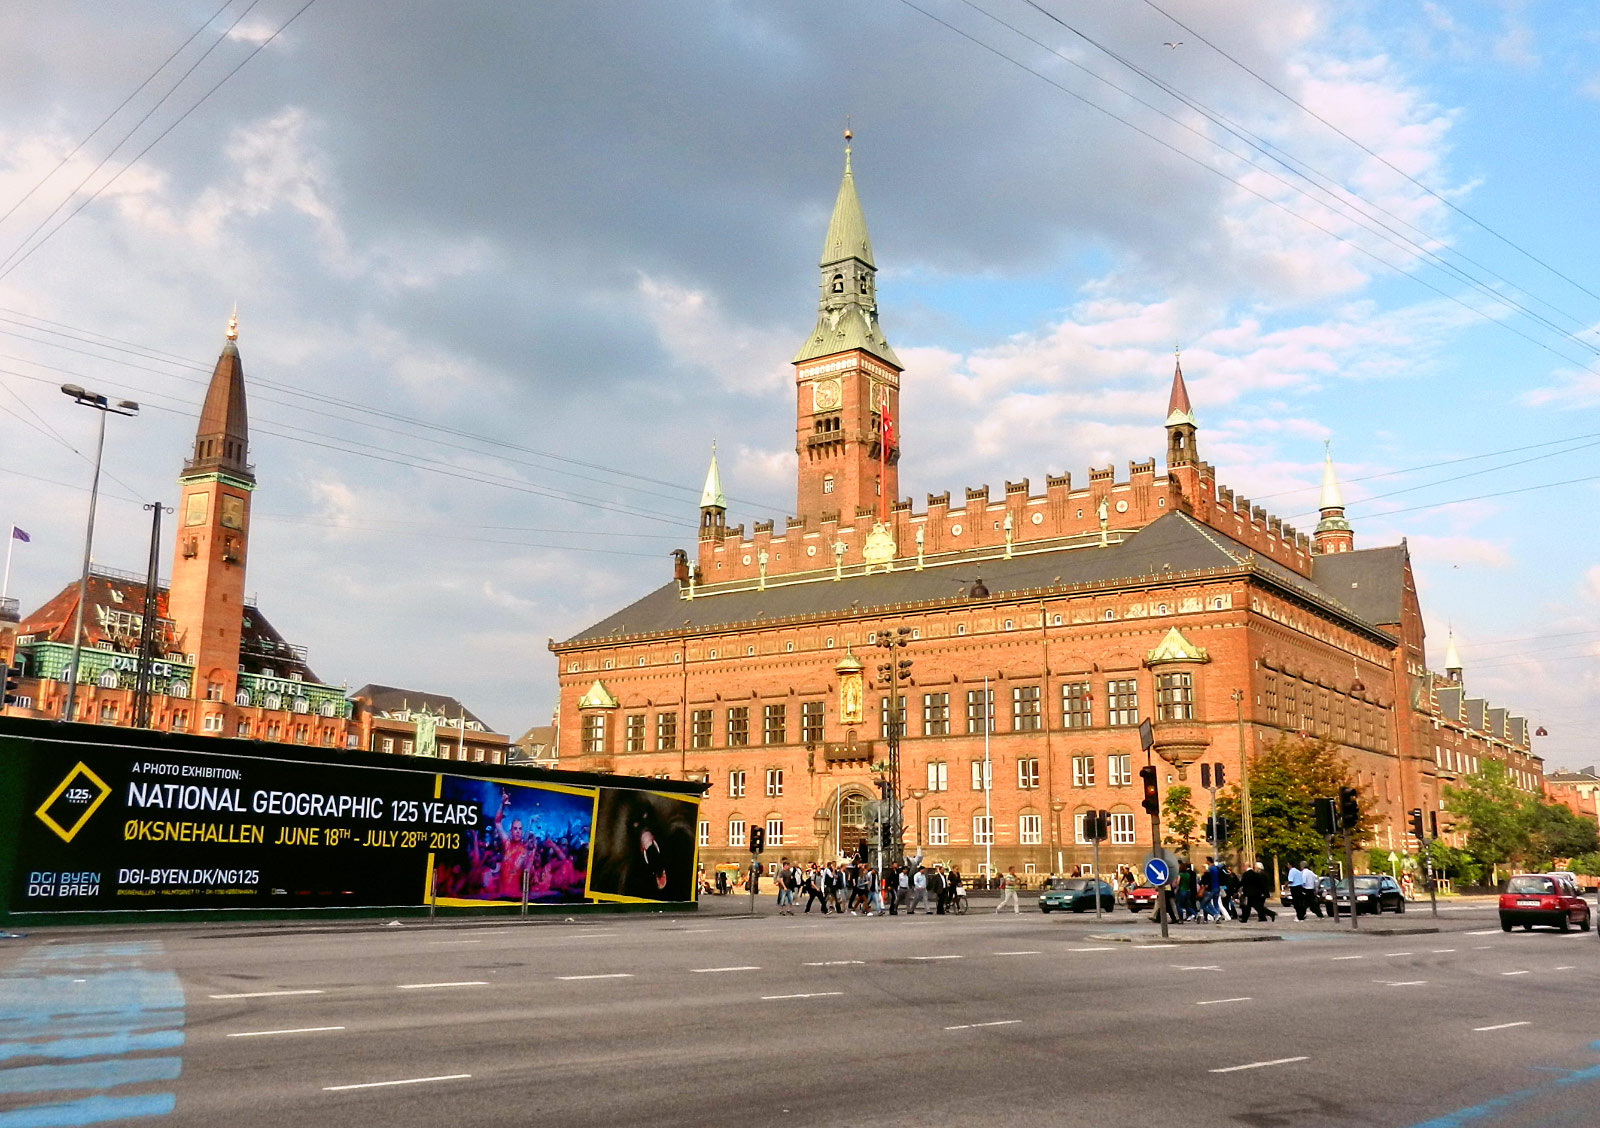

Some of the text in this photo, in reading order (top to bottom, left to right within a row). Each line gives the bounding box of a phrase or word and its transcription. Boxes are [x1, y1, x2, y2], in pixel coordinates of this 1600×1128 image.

[111, 656, 173, 677] PALCE
[255, 678, 303, 696] HOTEL
[132, 762, 242, 780] A PHOTO EXHIBITION:
[127, 781, 479, 826] NATIONAL GEOGRAPHIC 125 YEARS
[123, 819, 265, 844] ØKSNEHALLEN
[274, 827, 320, 846] JUNE
[323, 828, 352, 847] 18TH
[362, 830, 399, 848] JULY
[400, 831, 428, 848] 28TH
[429, 832, 461, 850] 2013
[30, 871, 101, 884] DGI BYEN
[118, 868, 260, 886] DGI-BYEN.DK/NG125
